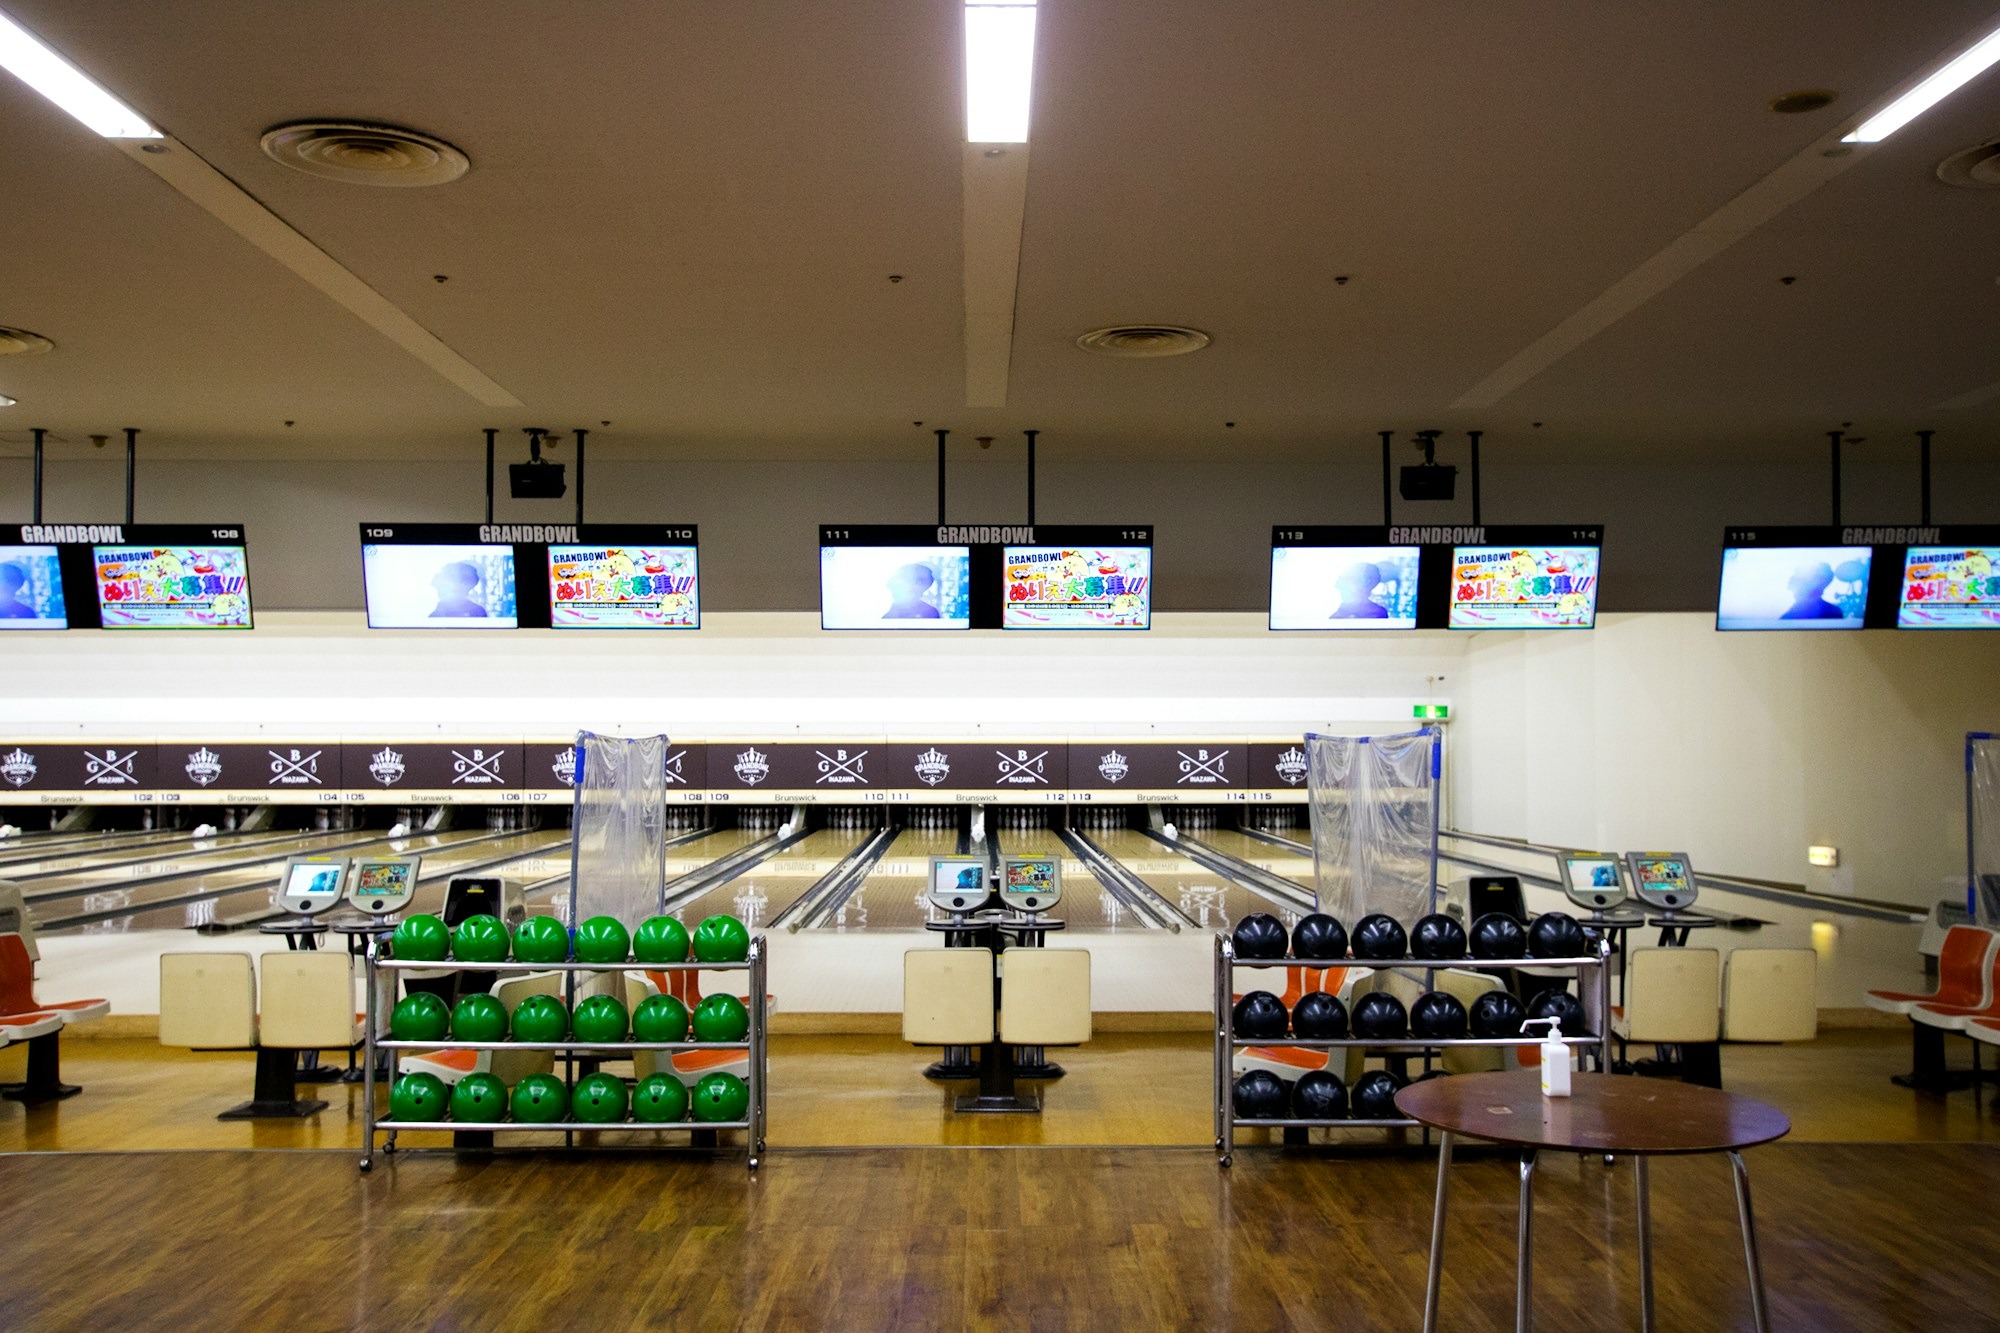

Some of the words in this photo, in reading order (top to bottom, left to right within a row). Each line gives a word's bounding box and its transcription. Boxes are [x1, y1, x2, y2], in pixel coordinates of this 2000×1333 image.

[21, 525, 125, 543] GRANDBOWL
[212, 530, 238, 538] 108
[366, 528, 393, 537] 109
[479, 525, 580, 542] GRANDBOWL
[666, 530, 692, 538] 110
[826, 530, 849, 538] 111
[937, 526, 1036, 544] GRANDBOWL
[1122, 531, 1147, 540] 112
[1279, 532, 1304, 540] 113
[1388, 527, 1486, 544] GRANDBOWL
[1572, 531, 1596, 539] 114
[1732, 532, 1756, 540] 115
[1842, 528, 1941, 544] GRANDBOWL
[98, 551, 154, 564] GRANDBOWL
[554, 552, 608, 564] GRANDBOWL
[1008, 552, 1062, 564] GRANDBOWL
[1458, 552, 1511, 564] GRANDBOWL
[106, 750, 117, 762] B
[290, 750, 300, 762] B
[474, 750, 484, 762] B
[838, 750, 847, 761] B
[1018, 750, 1028, 761] B
[1199, 750, 1208, 761] B
[86, 760, 98, 774] G
[271, 760, 283, 773] G
[454, 760, 466, 772] G
[818, 760, 830, 772] G
[998, 760, 1010, 772] G
[1180, 760, 1191, 772] G
